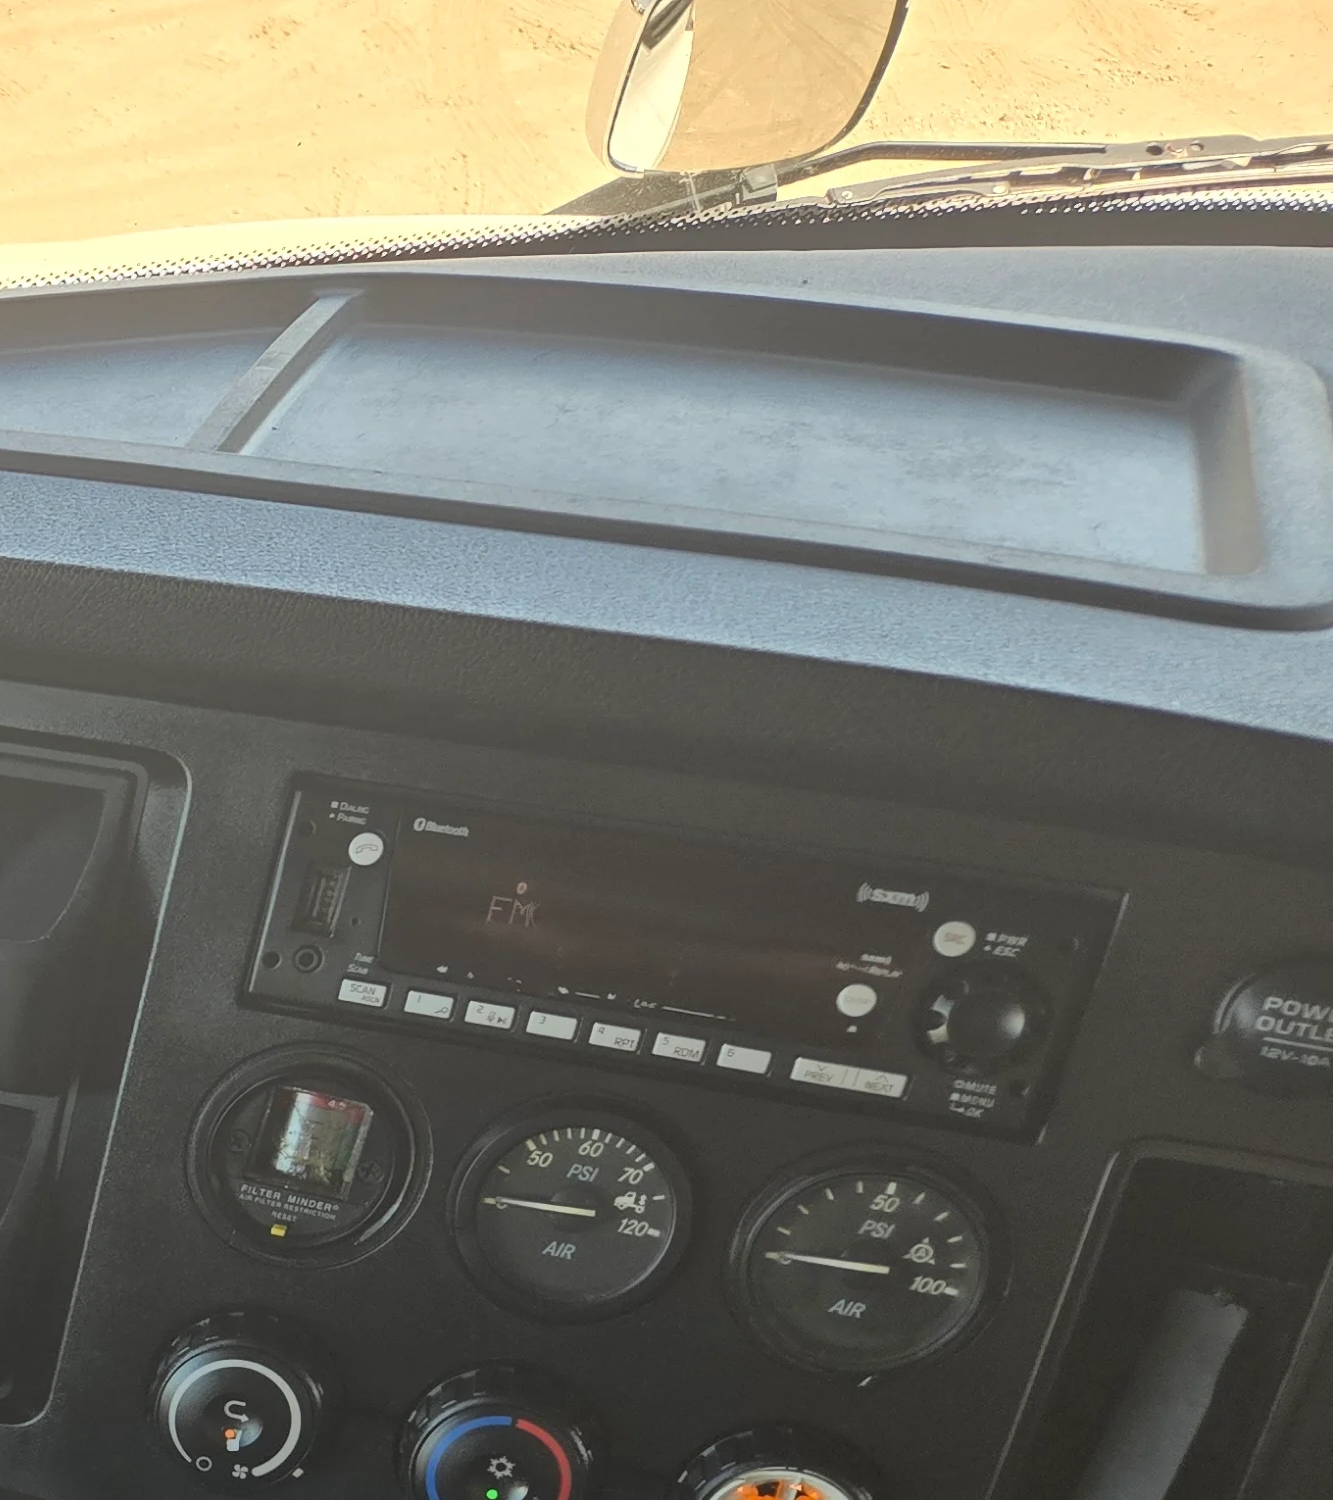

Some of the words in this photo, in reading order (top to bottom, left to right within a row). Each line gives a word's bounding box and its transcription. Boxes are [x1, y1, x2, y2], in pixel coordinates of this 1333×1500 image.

[674, 1047, 699, 1059] RDM
[804, 1070, 834, 1082] PREV
[578, 1141, 604, 1157] 60
[527, 1150, 553, 1167] 50
[566, 1164, 599, 1182] PSI
[617, 1167, 643, 1184] 70
[241, 1184, 281, 1200] FILTER
[870, 1195, 900, 1212] 50
[617, 1218, 649, 1237] 120
[857, 1220, 895, 1239] PSI
[542, 1241, 576, 1259] AIR
[909, 1276, 946, 1295] 100
[828, 1299, 866, 1318] AIR
